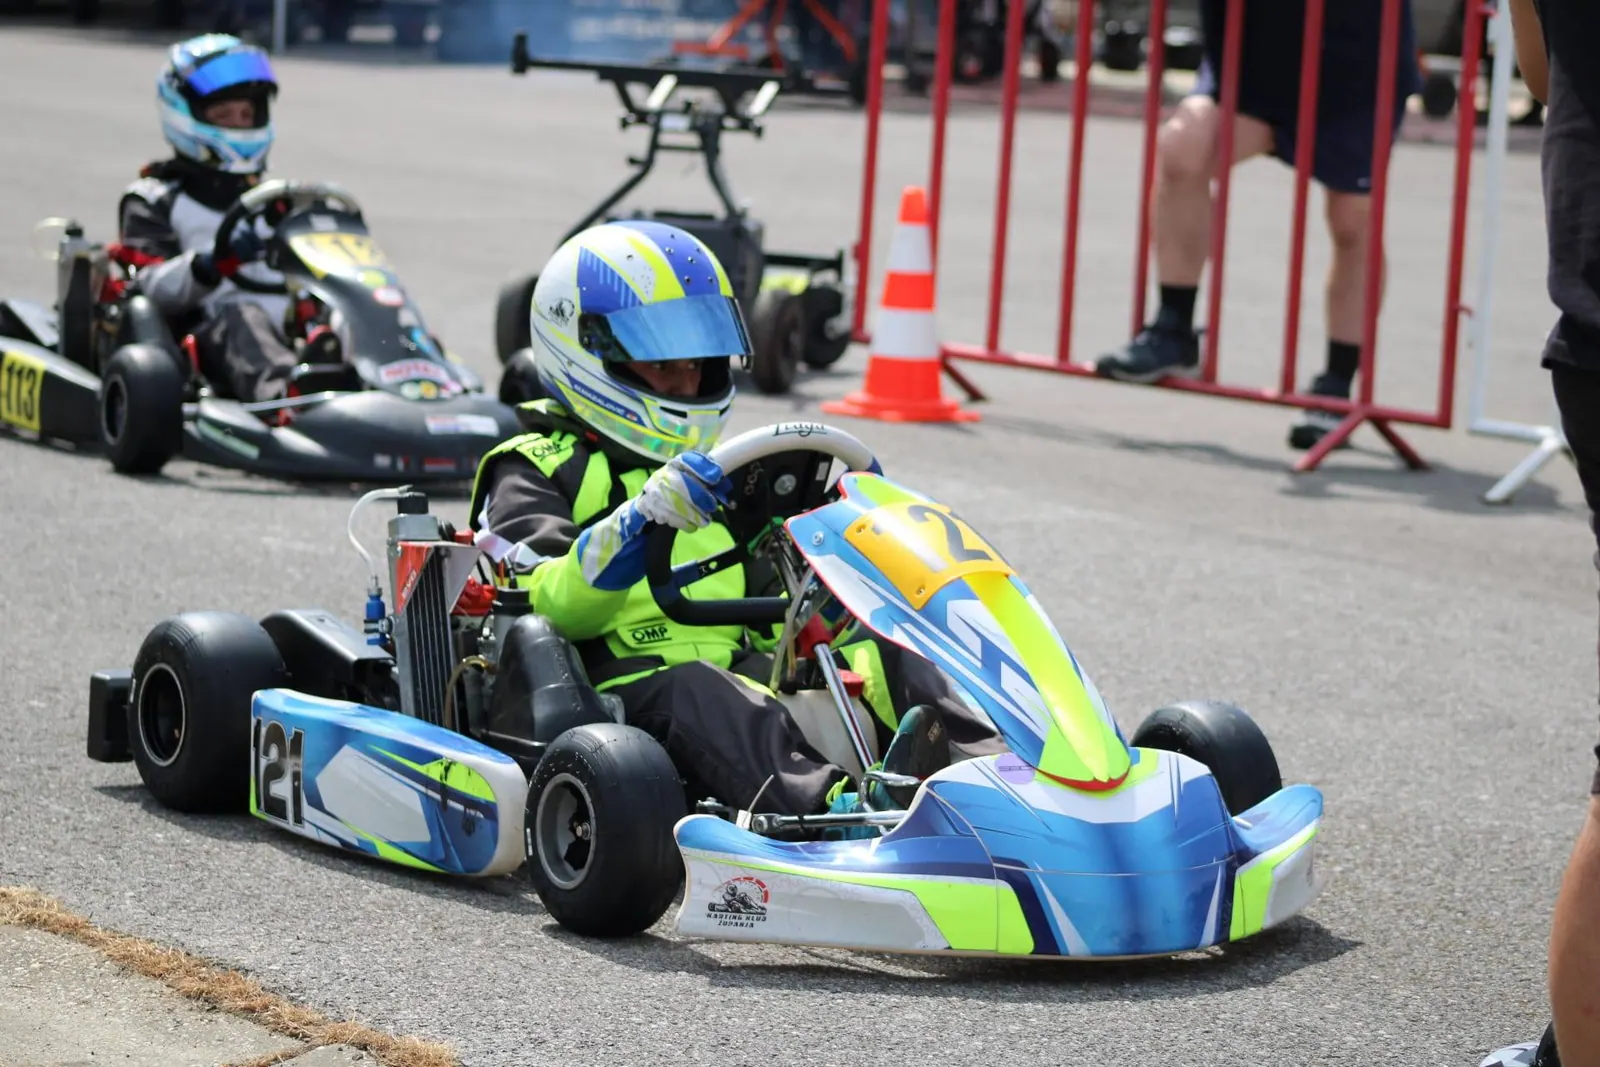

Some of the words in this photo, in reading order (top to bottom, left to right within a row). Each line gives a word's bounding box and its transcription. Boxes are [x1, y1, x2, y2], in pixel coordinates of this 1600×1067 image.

[7, 361, 37, 420] 113
[632, 626, 668, 641] OMP
[252, 717, 304, 827] 121
